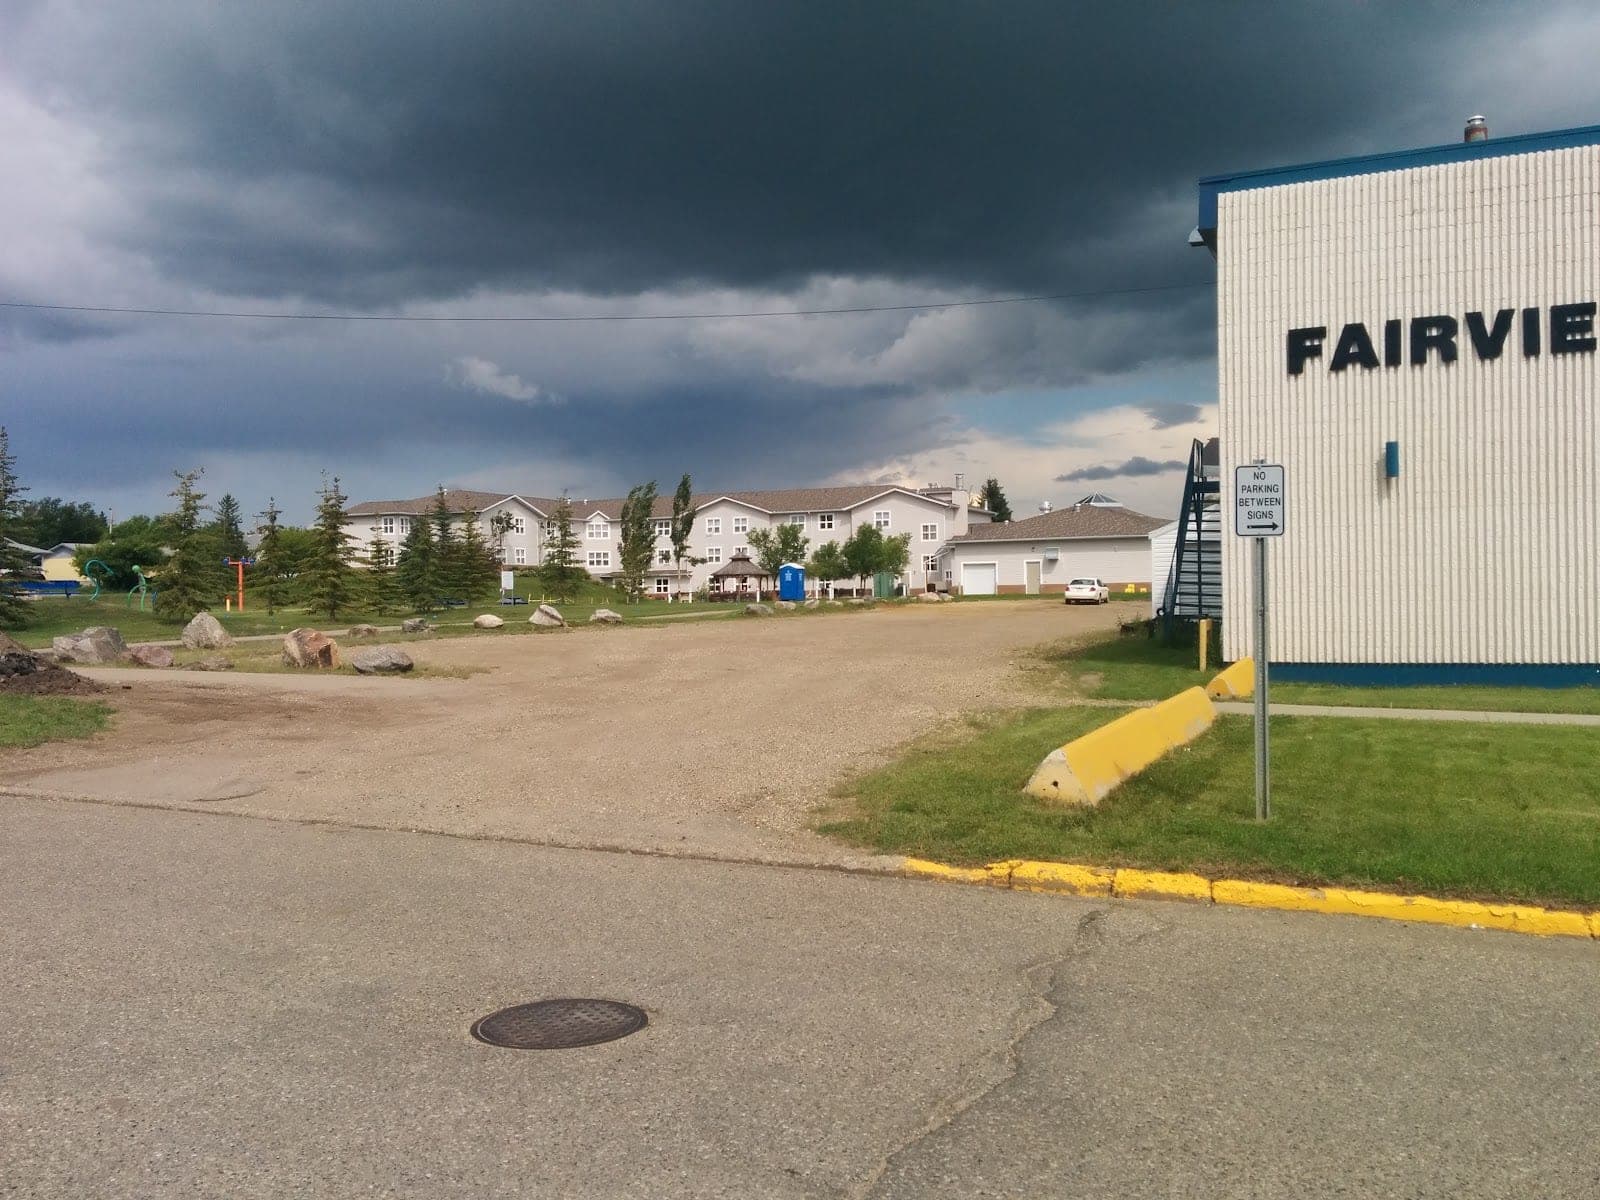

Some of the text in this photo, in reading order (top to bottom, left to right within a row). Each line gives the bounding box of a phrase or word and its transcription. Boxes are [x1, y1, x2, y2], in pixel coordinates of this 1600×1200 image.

[1287, 302, 1597, 375] FAIRVIE
[1253, 471, 1266, 480] NO
[1241, 484, 1279, 493] PARKING
[1239, 497, 1281, 507] BETWEEN
[1247, 510, 1274, 520] SIGNS
